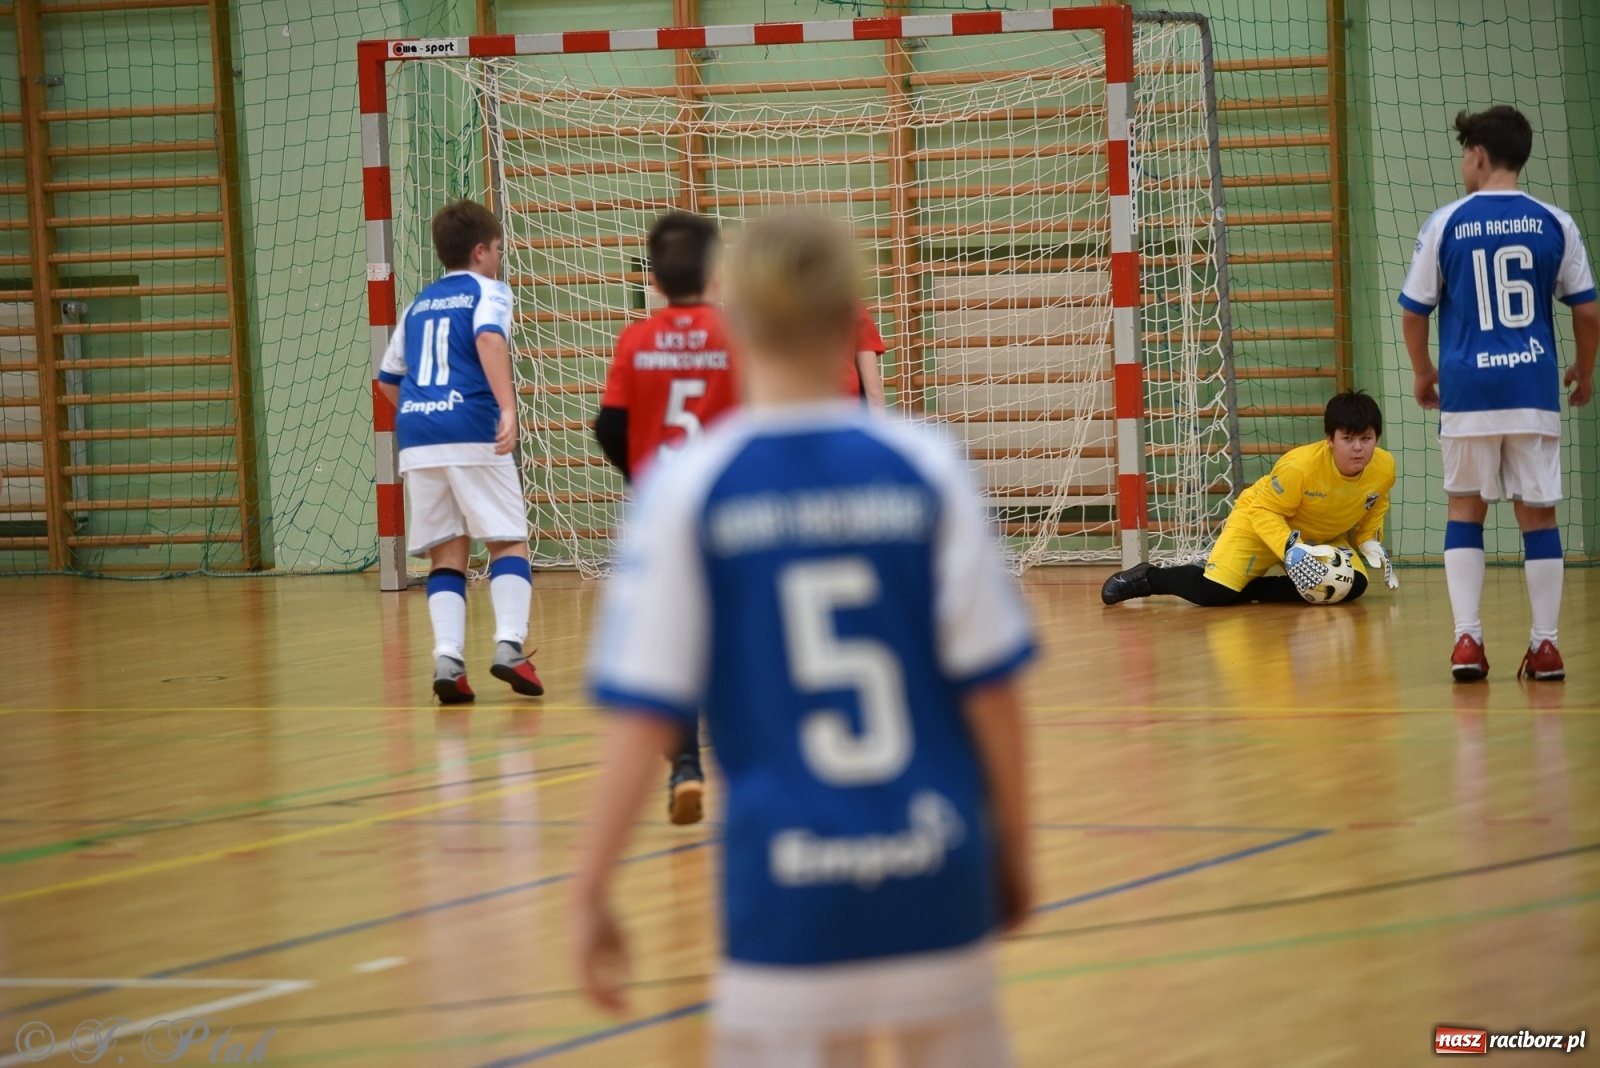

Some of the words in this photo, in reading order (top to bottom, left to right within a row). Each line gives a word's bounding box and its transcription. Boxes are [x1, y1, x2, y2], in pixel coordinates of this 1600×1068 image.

[425, 42, 454, 55] sport
[1455, 221, 1482, 240] UNIA
[1486, 215, 1543, 237] RACIBÓRZ
[1472, 245, 1535, 331] 16
[417, 317, 450, 387] 11
[776, 555, 915, 788] 5
